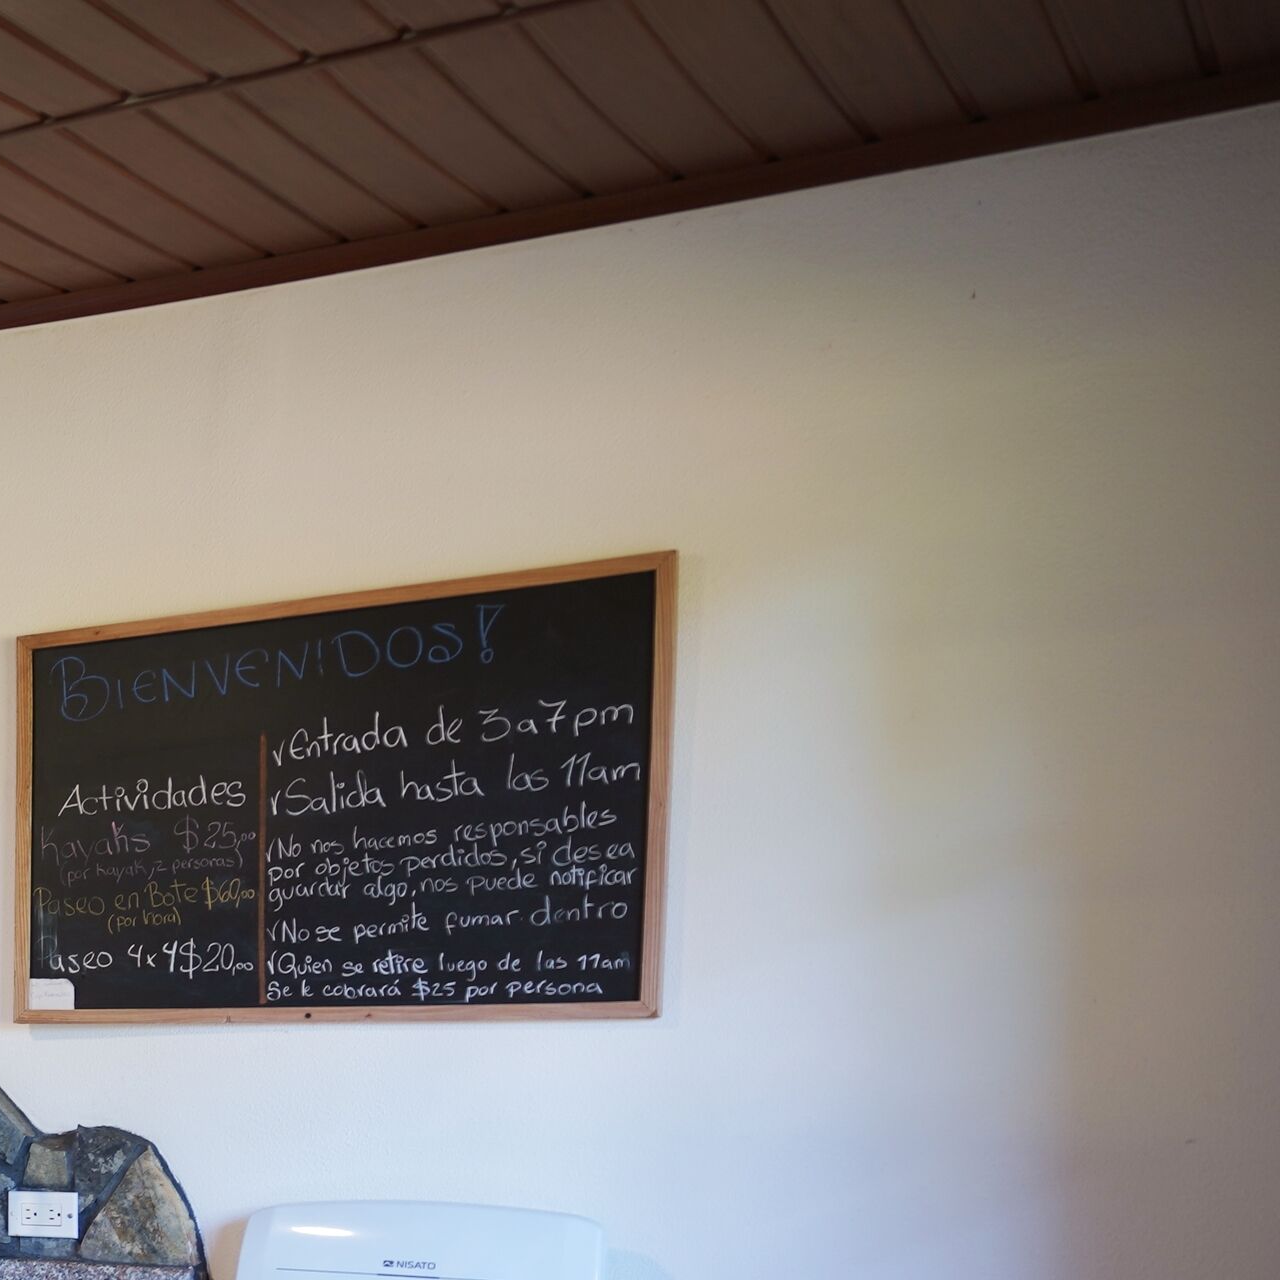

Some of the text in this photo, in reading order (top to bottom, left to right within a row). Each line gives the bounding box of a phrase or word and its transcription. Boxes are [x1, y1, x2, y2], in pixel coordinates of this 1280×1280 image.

[51, 605, 505, 721] BIENVENIDOS!
[290, 711, 408, 760] Entrada
[426, 704, 463, 746] de
[58, 775, 246, 816] Actividades
[285, 751, 641, 816] Salida hasta las 11am
[41, 821, 151, 866] Kayaks
[277, 800, 617, 859] No nos hacemos responsables
[267, 862, 306, 886] por
[314, 852, 396, 887] objetos
[552, 836, 635, 867] desea
[32, 887, 105, 916] Paseo
[115, 893, 139, 910] en
[144, 879, 198, 908] Bote
[268, 876, 351, 912] guardar
[420, 877, 459, 893] nos
[466, 868, 539, 896] puede
[549, 863, 638, 890] notificar
[107, 914, 137, 934] (por
[282, 917, 310, 944] No
[315, 925, 342, 942] se
[353, 901, 430, 944] permite
[530, 892, 628, 927] dentro
[277, 948, 631, 982] Quien se retire luego de las 11am
[266, 980, 293, 1001] Se
[322, 979, 402, 1000] cobrará
[411, 977, 457, 1001] $25
[466, 981, 498, 1003] por
[505, 979, 604, 998] persona
[396, 1260, 437, 1270] NISATO
